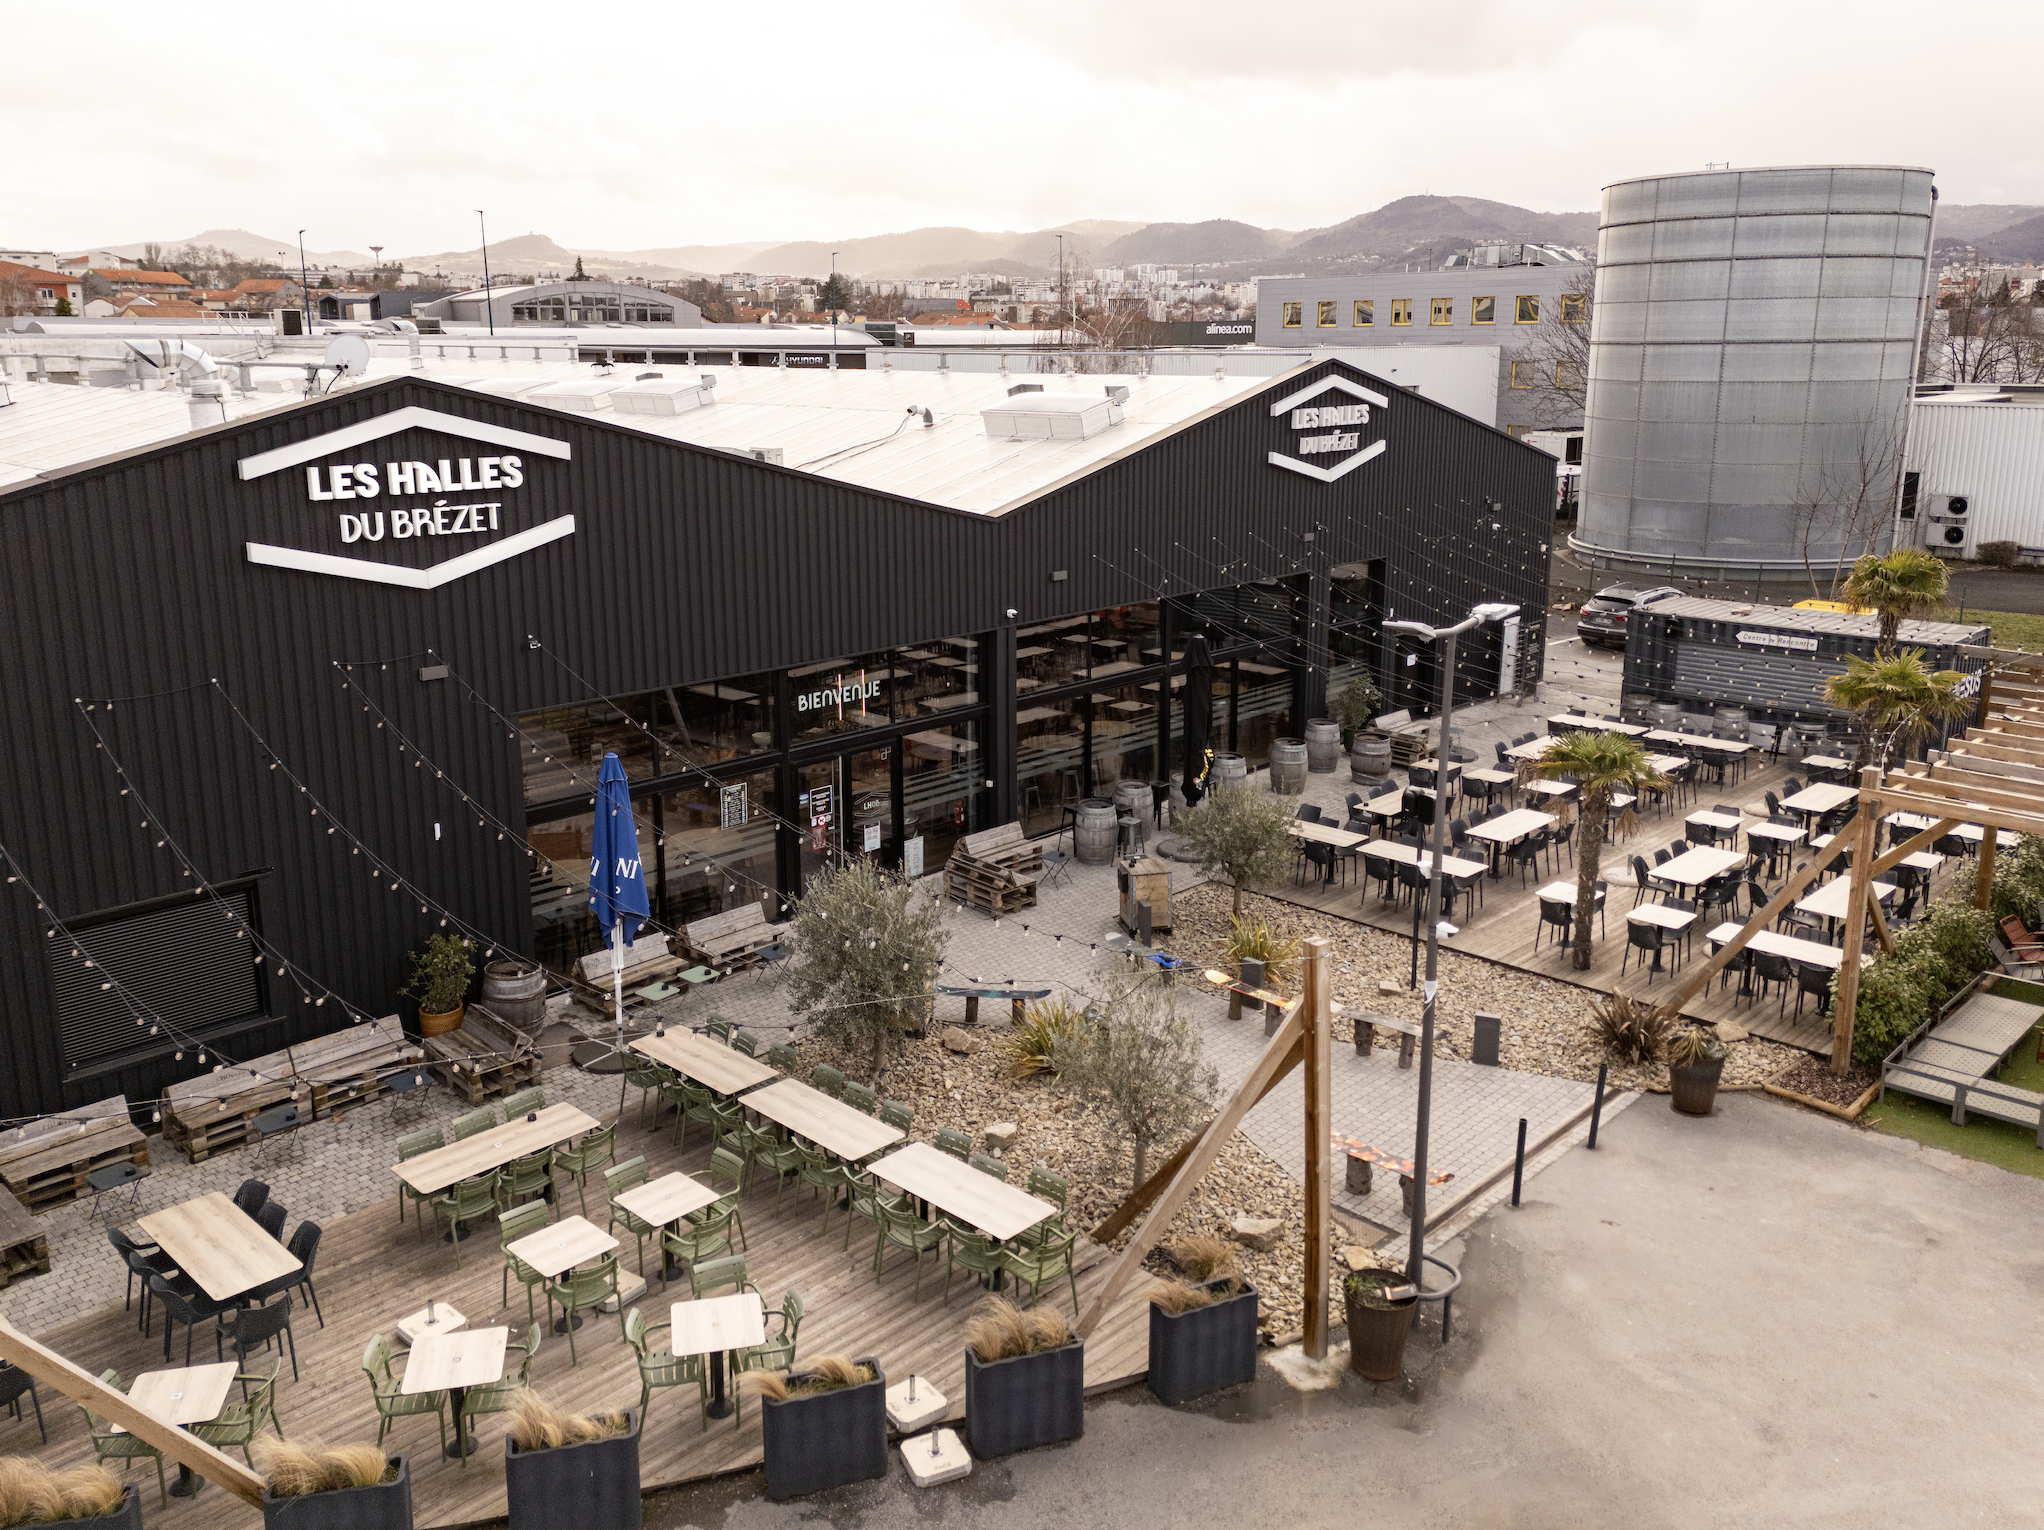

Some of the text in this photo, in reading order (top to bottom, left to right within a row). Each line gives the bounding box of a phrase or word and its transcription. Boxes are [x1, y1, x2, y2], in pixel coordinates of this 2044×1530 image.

[1206, 323, 1252, 334] alinea.com
[1291, 404, 1369, 429] LES HALLES
[1299, 429, 1360, 455] DU BRÉZET
[307, 455, 524, 501] LES HALLES
[339, 499, 502, 544] DU BRÉZET
[1743, 633, 1767, 642] Centre
[1777, 637, 1815, 648] Rencontre
[798, 680, 881, 712] BIENVENUE
